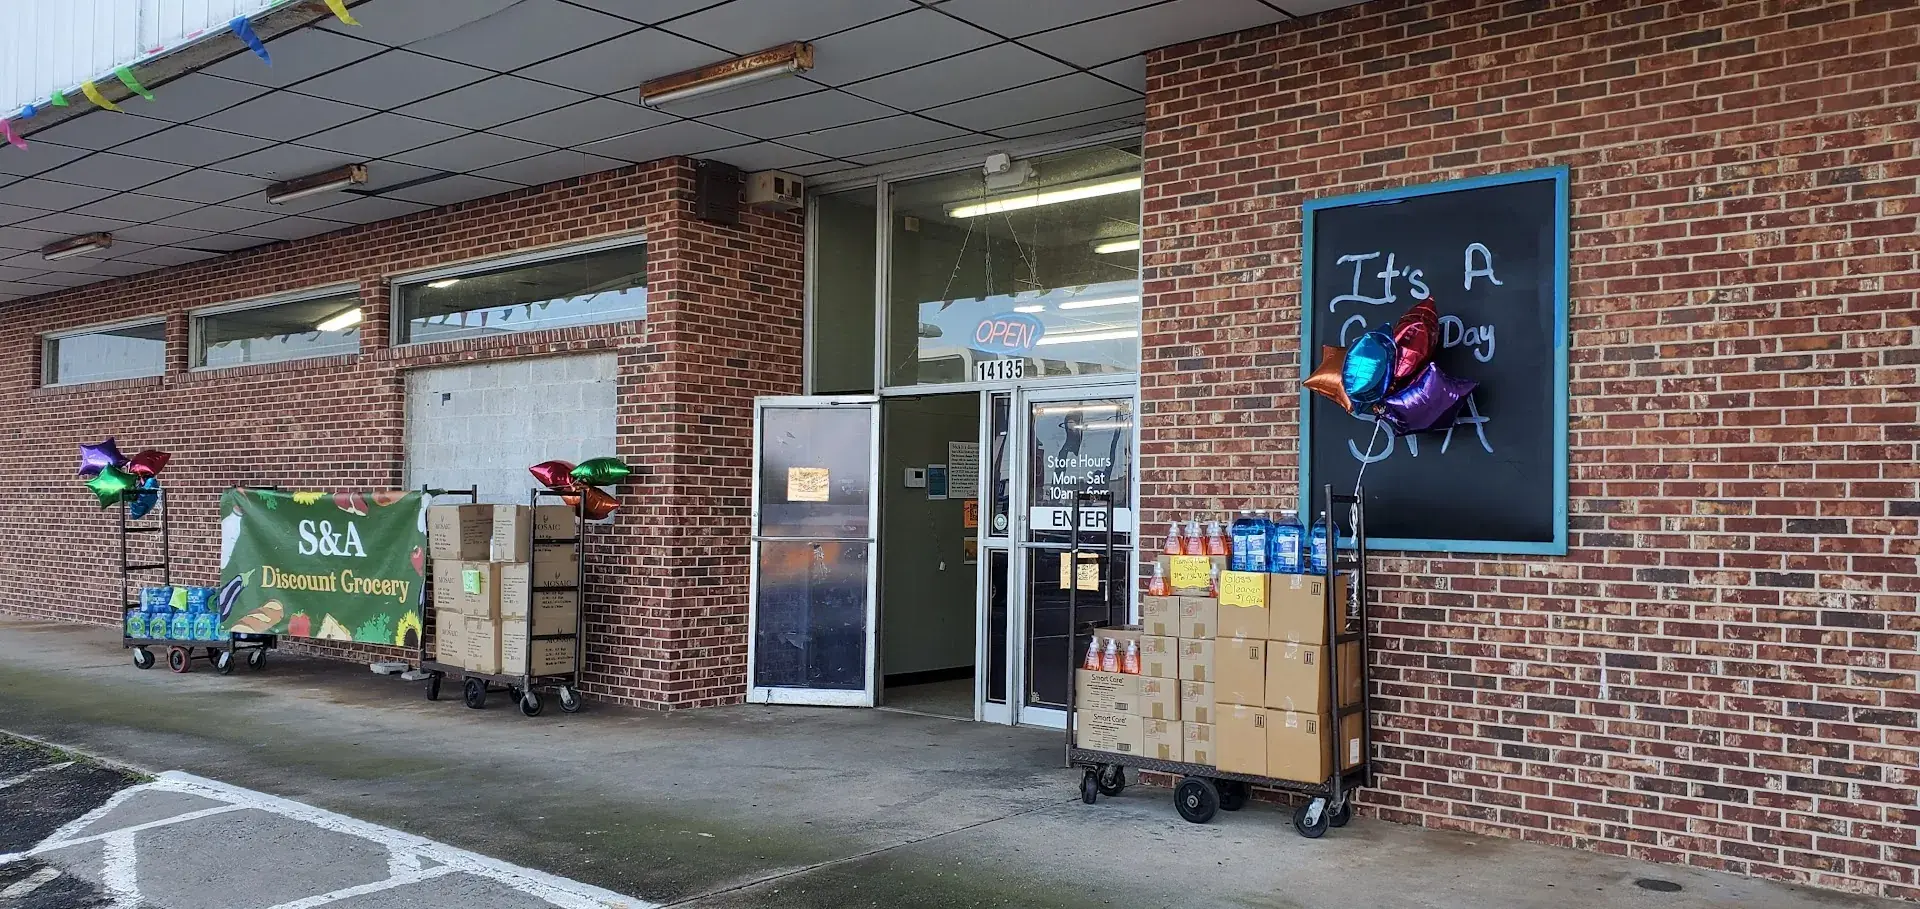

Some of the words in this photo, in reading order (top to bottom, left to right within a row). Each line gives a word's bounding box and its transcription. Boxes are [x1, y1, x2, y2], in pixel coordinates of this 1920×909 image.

[1330, 251, 1431, 313] It's
[1464, 242, 1504, 291] A
[976, 319, 1036, 349] OPEN
[1438, 315, 1495, 363] Day
[979, 359, 1023, 381] 14135
[1348, 393, 1494, 463] SA
[1047, 455, 1077, 468] Store
[1079, 453, 1111, 468] Hours
[1053, 471, 1077, 485] Mon
[1086, 470, 1105, 485] Sat
[298, 518, 368, 558] S&A
[260, 565, 337, 593] Discount
[340, 568, 410, 604] Grocery
[1224, 583, 1261, 595] Cleaner
[1091, 673, 1109, 682] Smart
[1093, 713, 1111, 722] Smart
